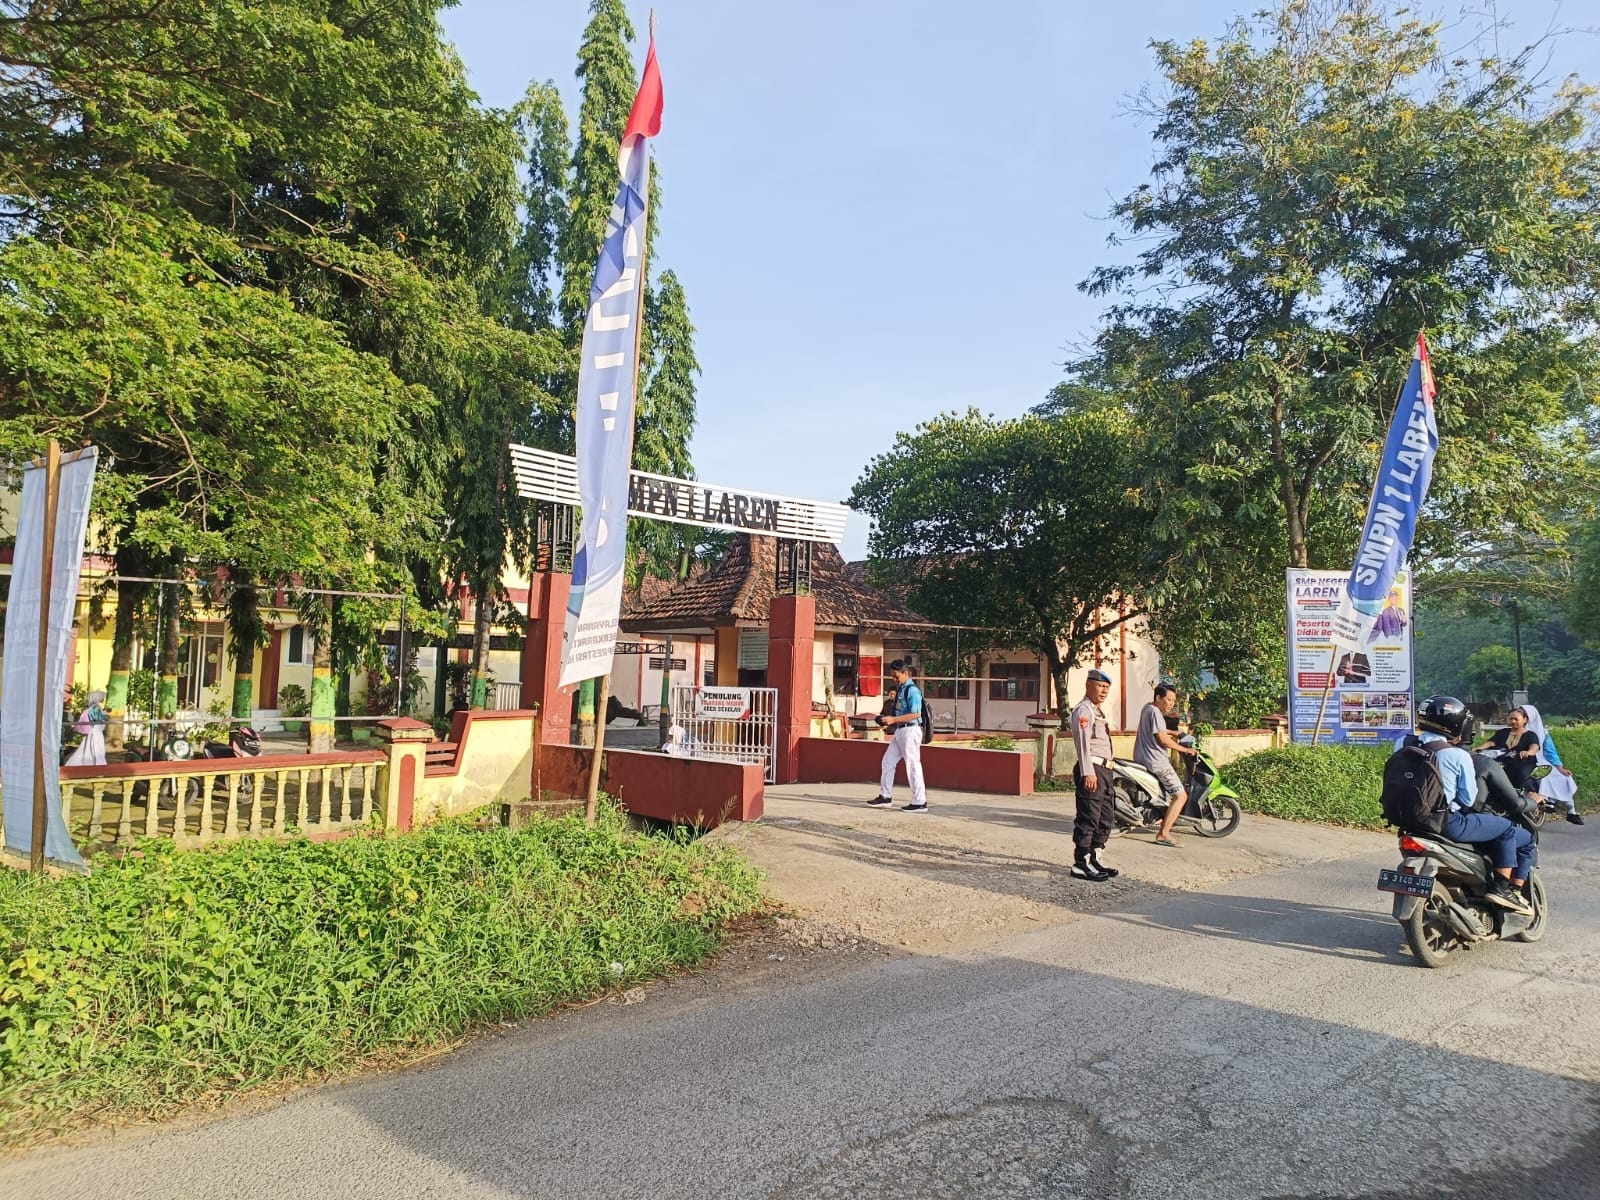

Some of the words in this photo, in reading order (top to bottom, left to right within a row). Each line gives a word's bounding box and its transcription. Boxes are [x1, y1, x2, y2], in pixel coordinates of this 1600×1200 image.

[627, 474, 679, 517] MPN
[686, 487, 696, 520] 1
[703, 489, 780, 531] LAREN
[1355, 502, 1406, 586] SMPN
[1384, 485, 1410, 503] 1
[1296, 587, 1339, 597] LAREN
[1296, 628, 1319, 636] Didik
